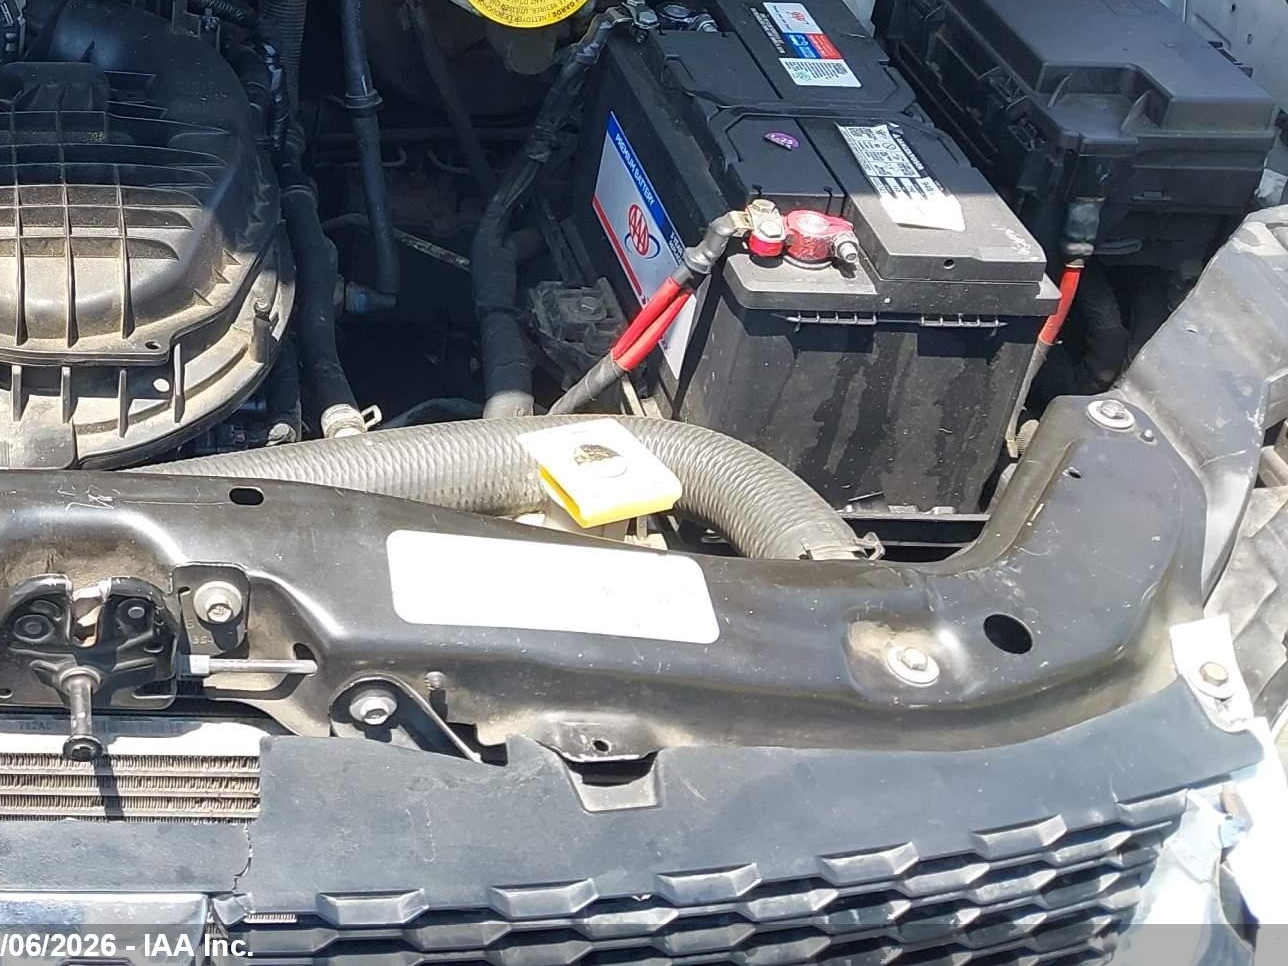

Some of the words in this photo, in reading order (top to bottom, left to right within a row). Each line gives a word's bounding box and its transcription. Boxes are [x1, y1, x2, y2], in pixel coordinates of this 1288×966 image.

[615, 133, 637, 173] PREMIUM
[634, 168, 655, 206] BATTERY
[629, 204, 650, 256] AAA
